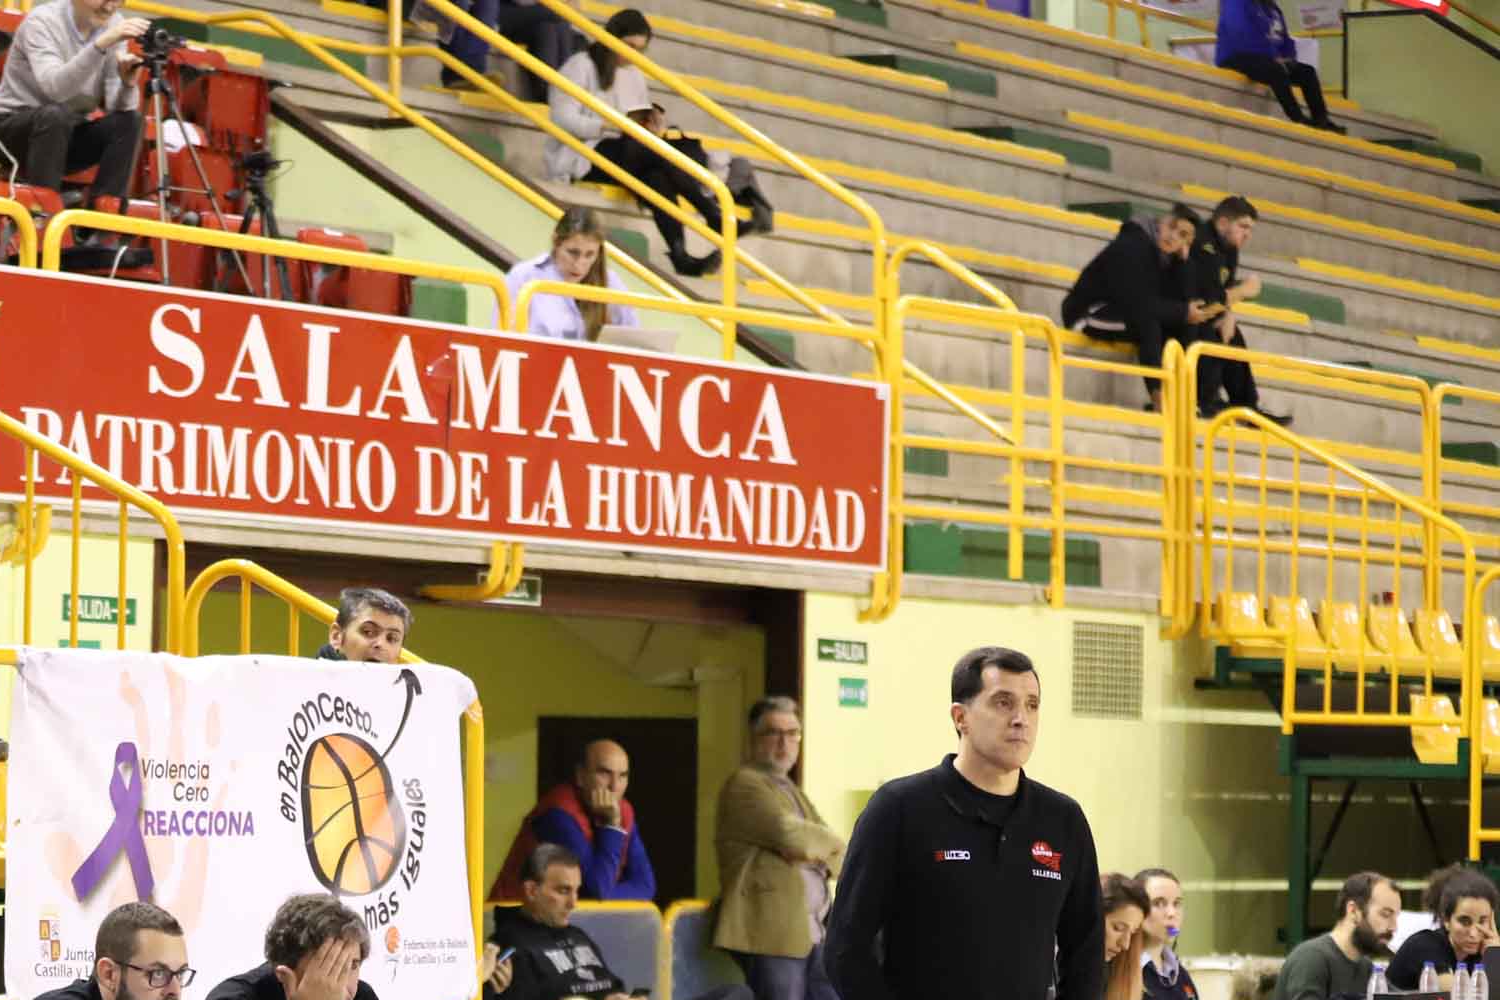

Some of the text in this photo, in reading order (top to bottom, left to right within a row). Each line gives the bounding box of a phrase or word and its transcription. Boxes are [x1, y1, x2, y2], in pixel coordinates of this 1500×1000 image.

[148, 304, 797, 465] SALAMANCA
[20, 406, 866, 554] PATRIMONIO DE LA HUMANIDAD
[141, 758, 211, 780] Violencia
[173, 781, 210, 802] Cero
[280, 791, 298, 823] en
[143, 810, 255, 837] REACCIONA
[364, 889, 400, 931] más
[63, 945, 95, 961] Junta
[34, 963, 73, 977] Castilla
